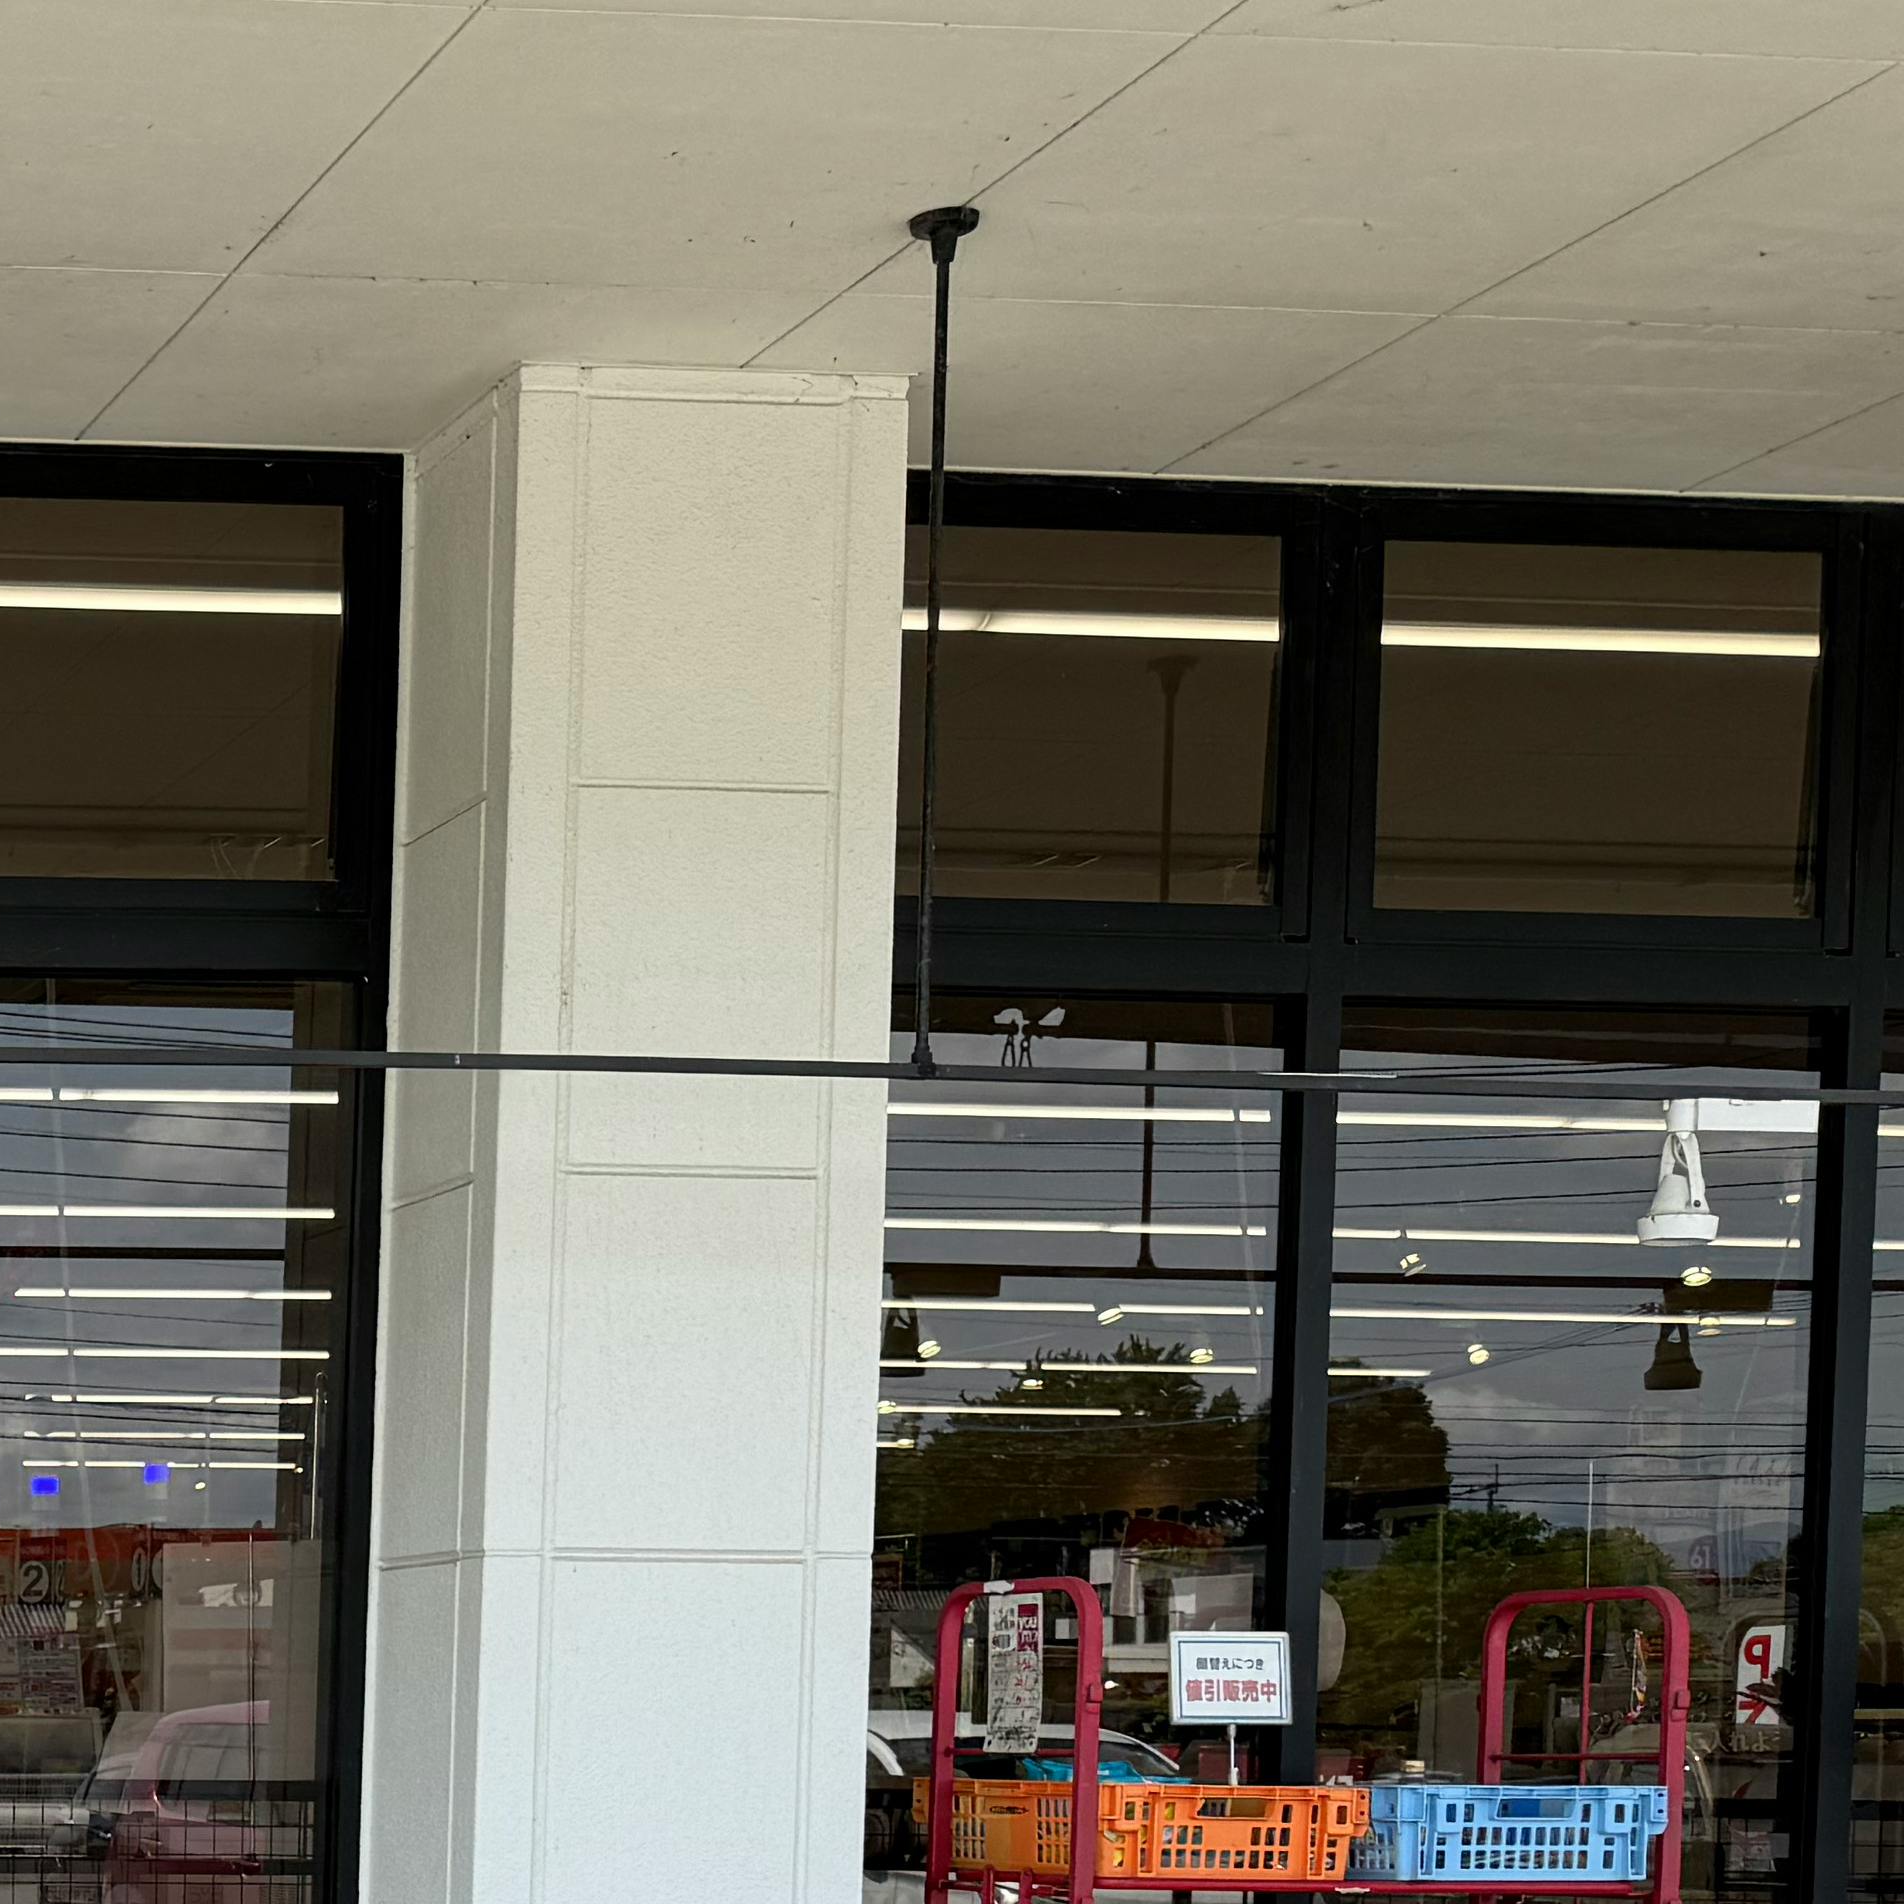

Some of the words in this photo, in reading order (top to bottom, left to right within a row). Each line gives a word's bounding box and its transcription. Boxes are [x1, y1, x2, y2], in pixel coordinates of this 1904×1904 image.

[22, 1565, 42, 1597] 2
[1186, 1679, 1277, 1702] 値引販売中
